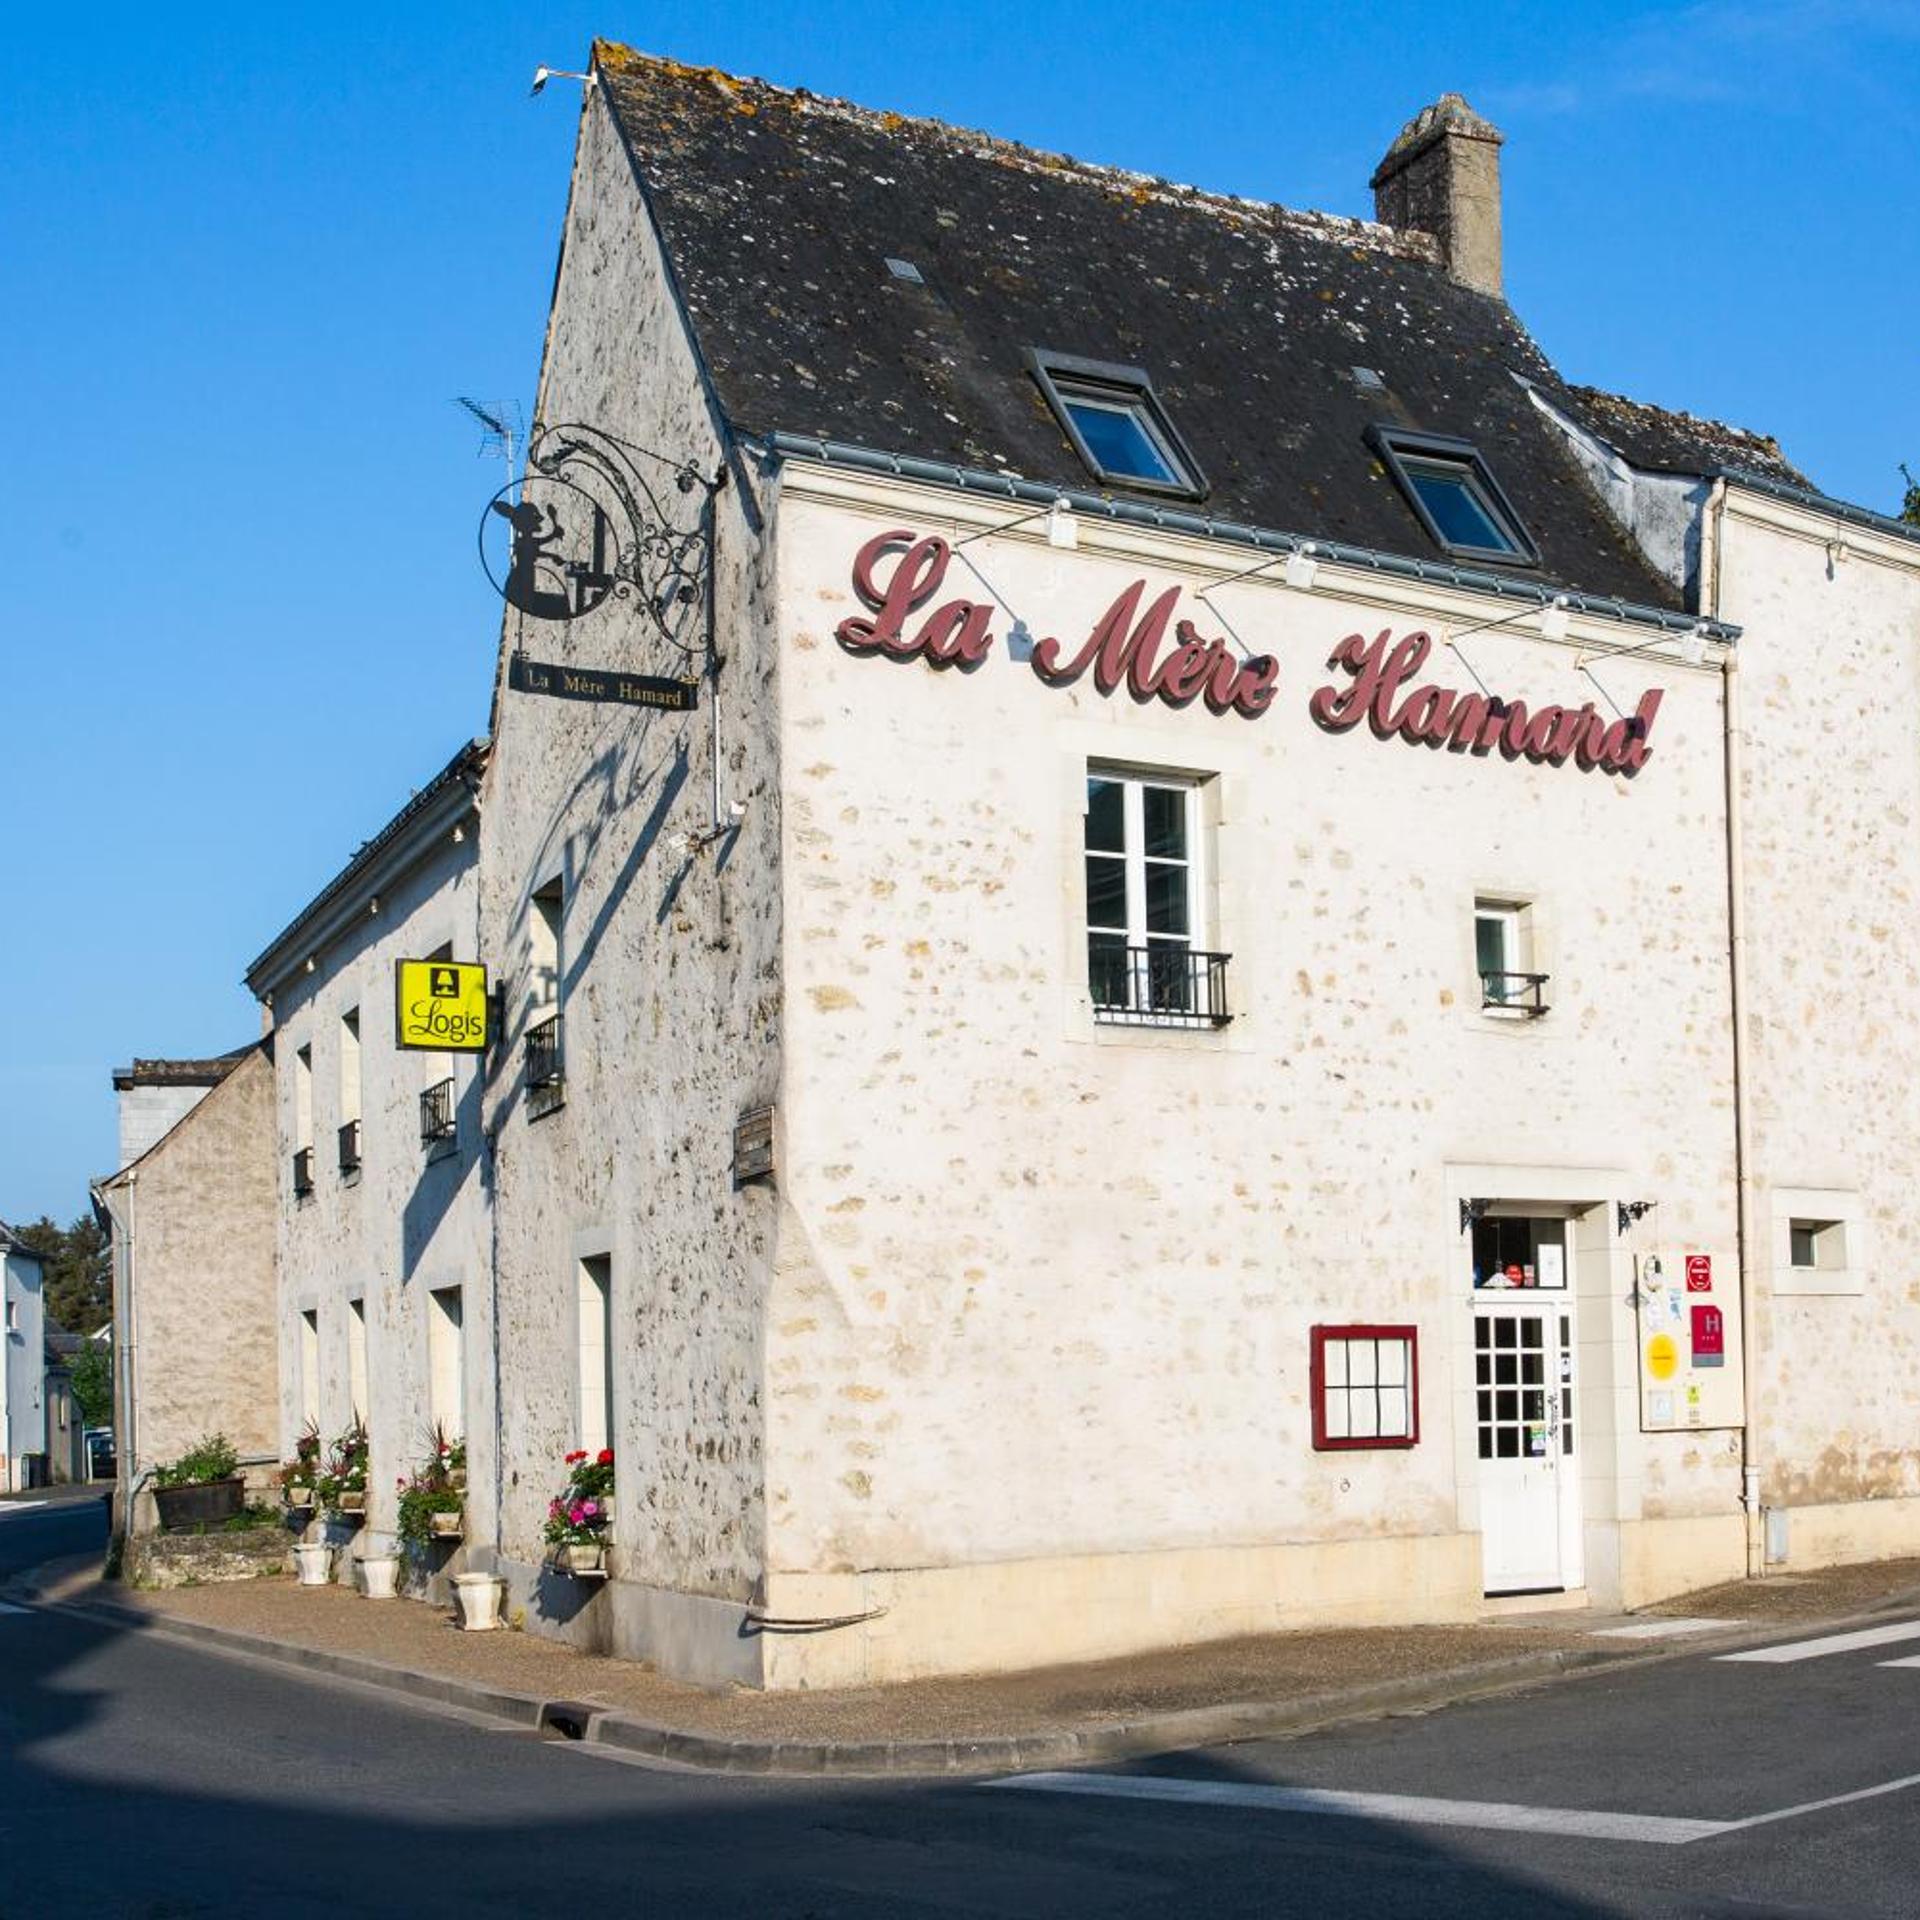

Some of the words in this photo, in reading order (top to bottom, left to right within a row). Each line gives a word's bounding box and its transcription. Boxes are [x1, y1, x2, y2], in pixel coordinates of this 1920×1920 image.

[836, 529, 995, 666] La
[1031, 578, 1280, 716] Mère
[1309, 627, 1665, 776] Hamard
[528, 669, 549, 688] La
[563, 673, 605, 695] Mère
[619, 682, 682, 706] Hamard
[408, 998, 483, 1043] Logis
[1705, 1313, 1719, 1333] H
